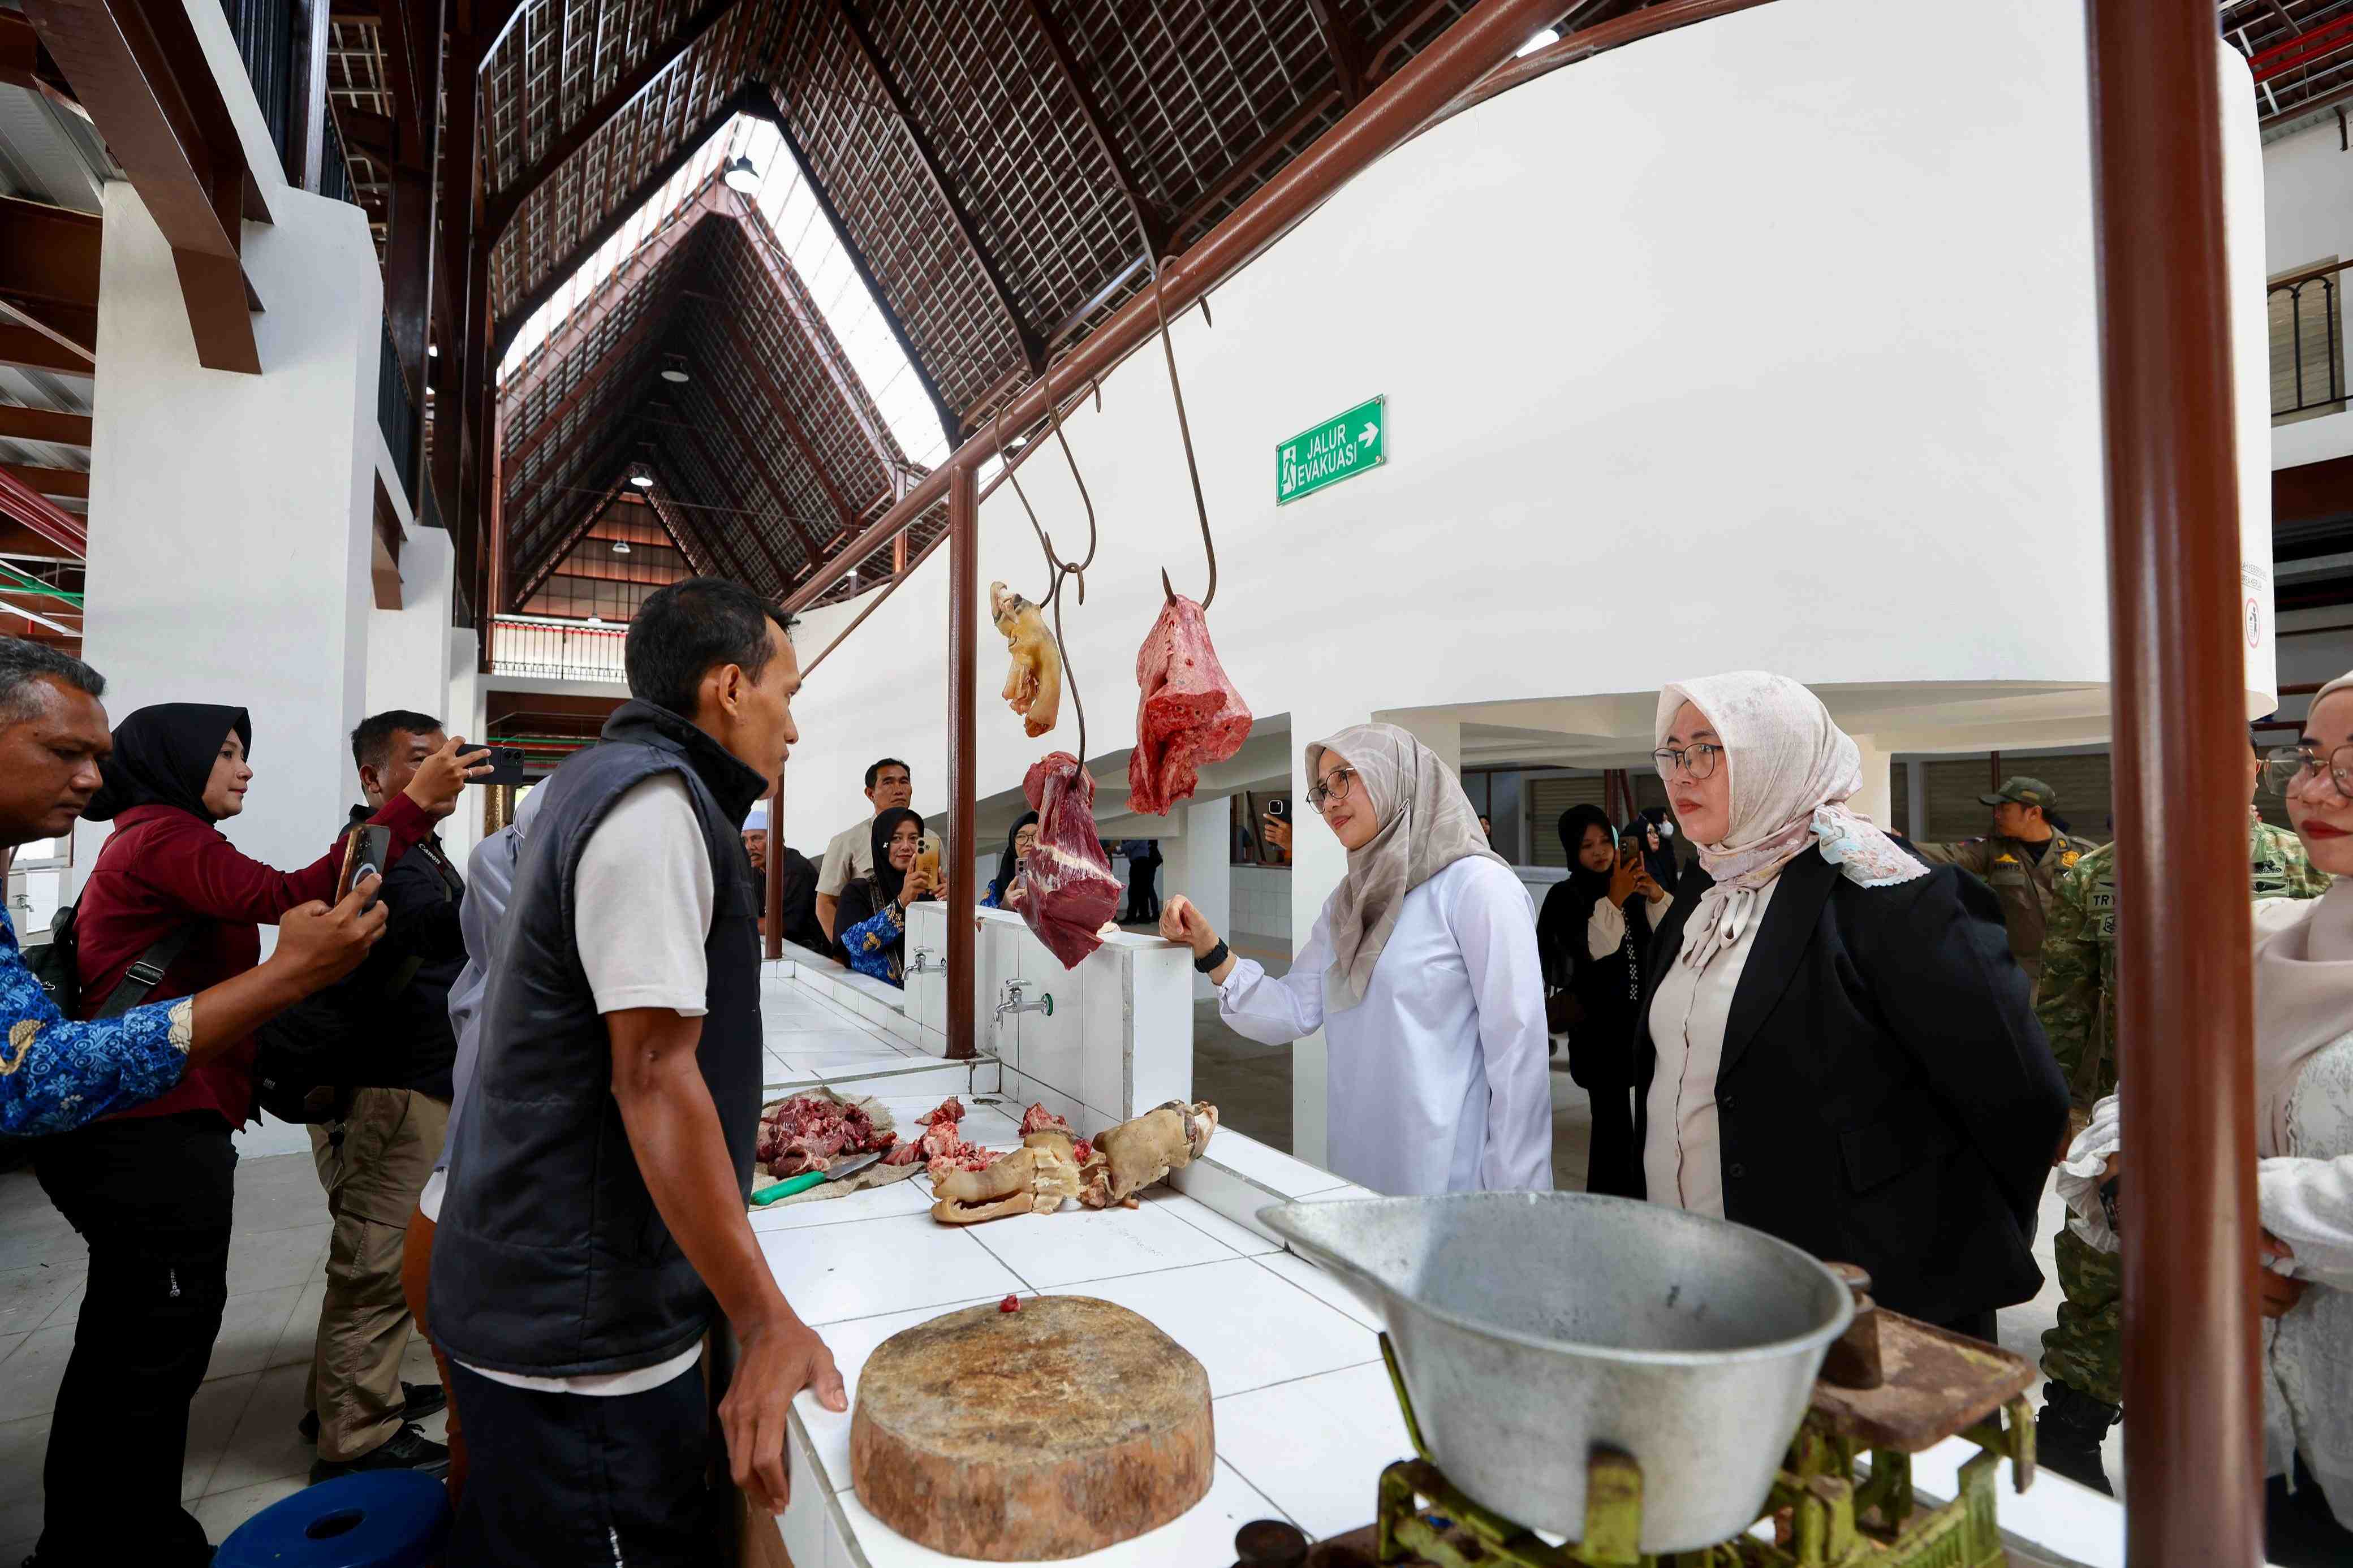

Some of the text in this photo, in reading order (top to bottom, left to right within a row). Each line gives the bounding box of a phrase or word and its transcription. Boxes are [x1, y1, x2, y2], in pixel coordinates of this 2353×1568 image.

[1307, 424, 1346, 460] JALUR
[1298, 441, 1357, 486] EVAKUASI
[419, 843, 441, 865] Canon
